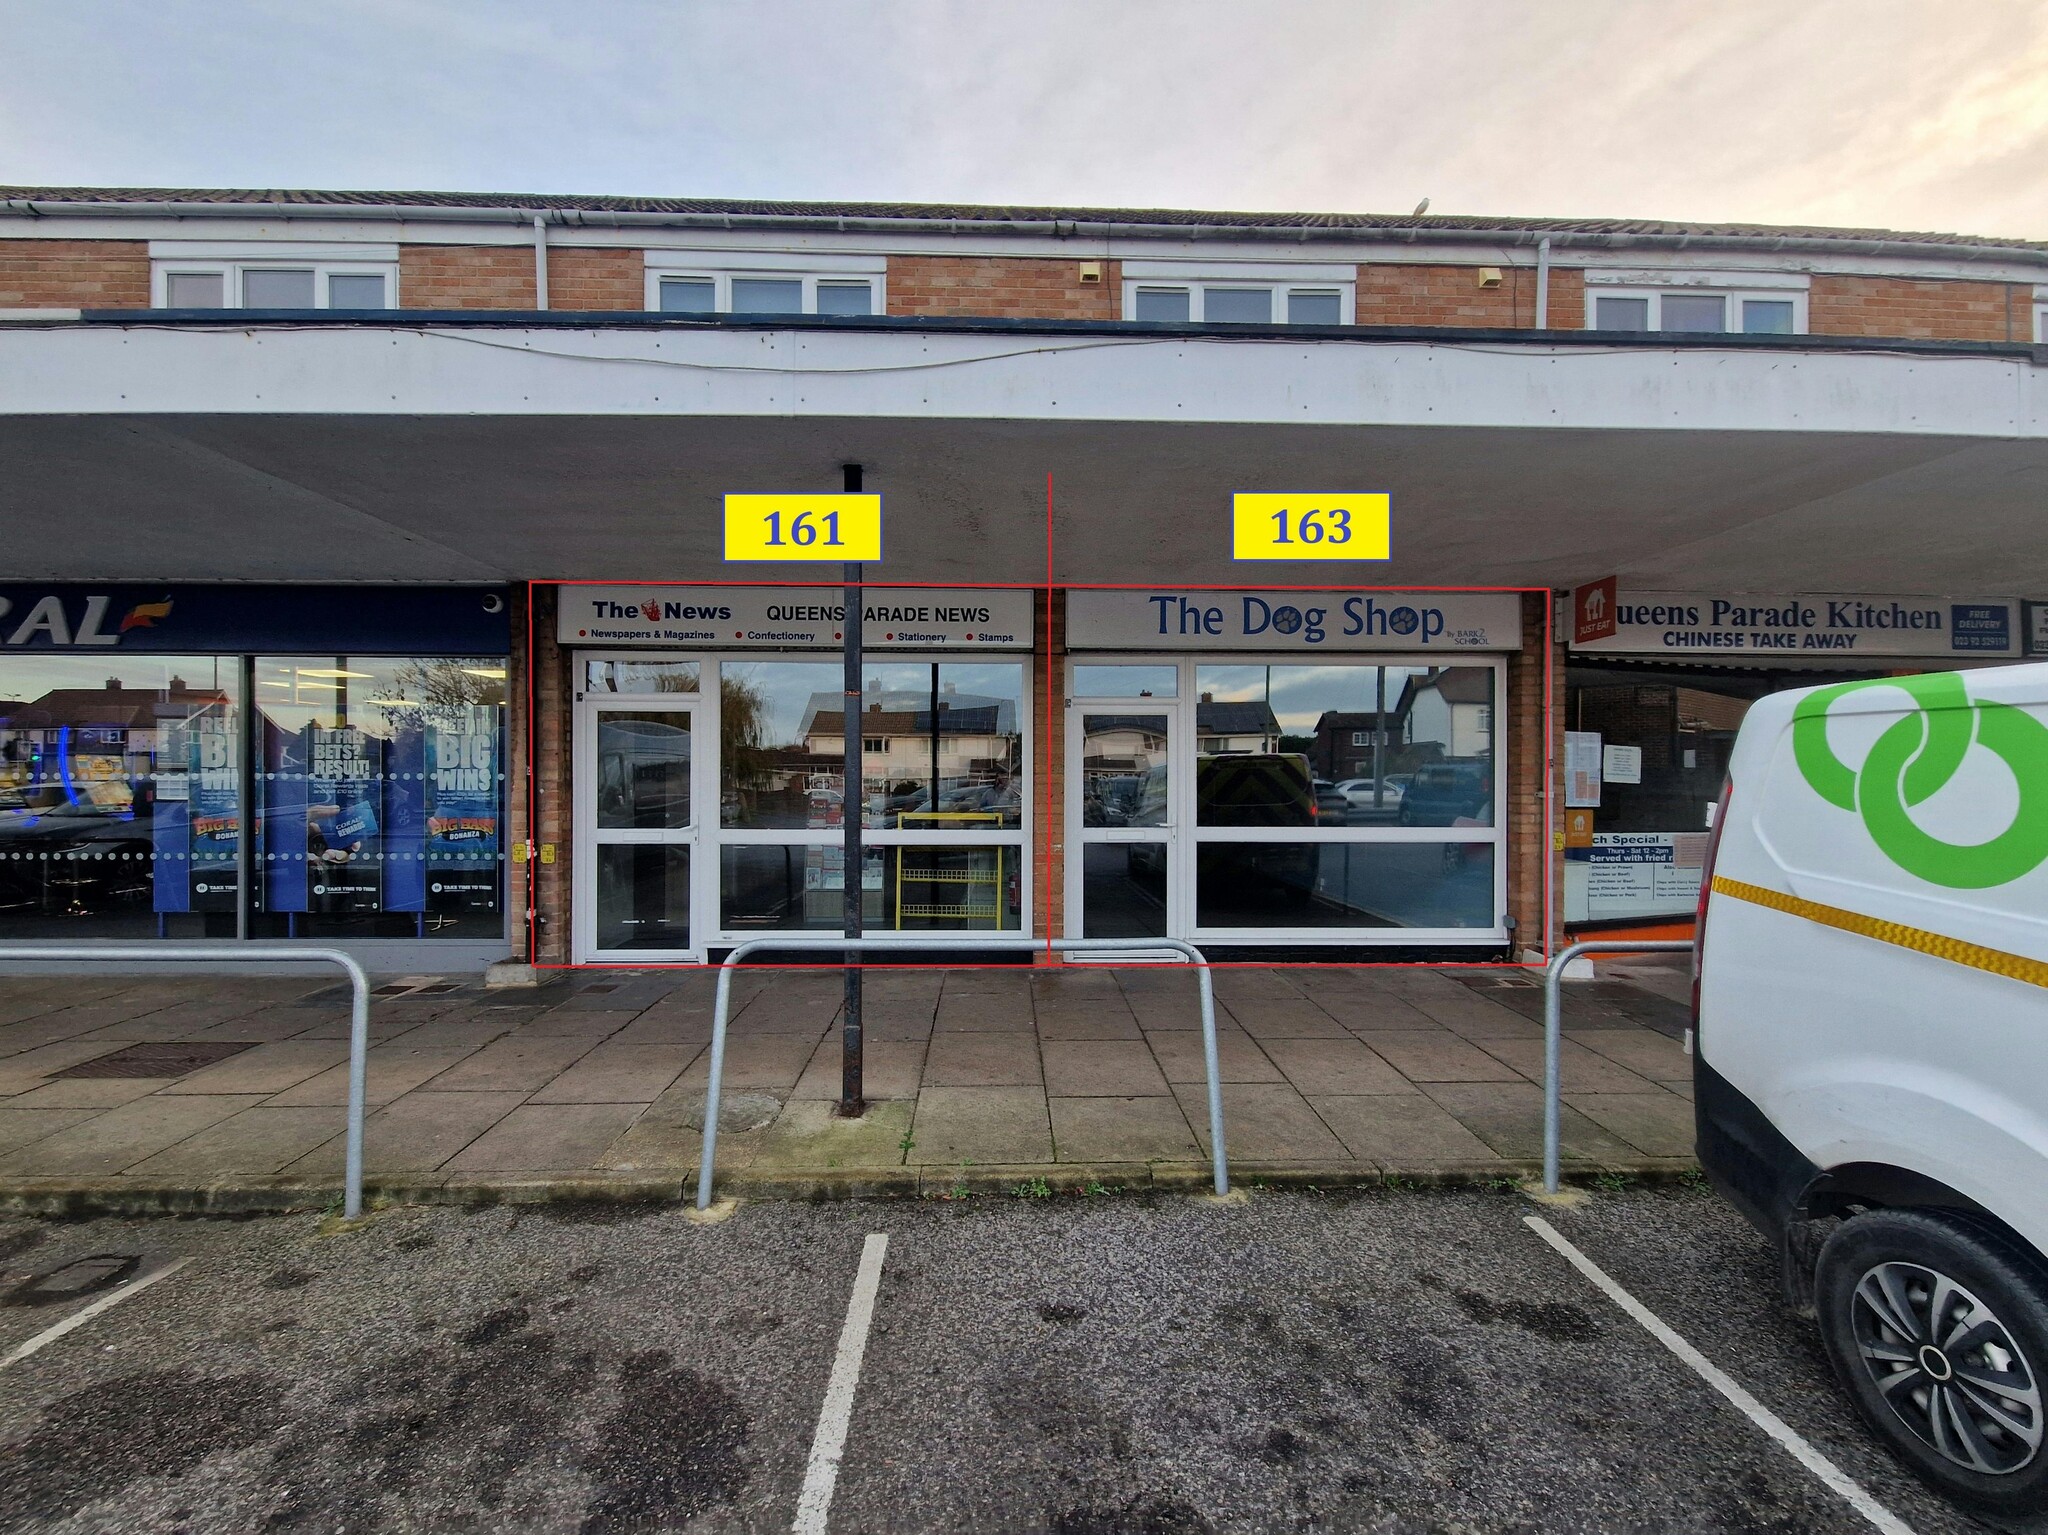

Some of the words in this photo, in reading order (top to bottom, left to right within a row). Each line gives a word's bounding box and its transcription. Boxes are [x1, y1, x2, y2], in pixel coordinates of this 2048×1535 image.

[592, 601, 639, 619] The
[664, 602, 731, 620] News
[767, 605, 845, 621] QUEENS
[863, 607, 929, 622] ARADE
[935, 607, 990, 622] NEWS
[1616, 605, 1700, 626] ueens
[1709, 599, 1816, 628] Parade
[1825, 601, 1942, 630] Kitchen
[1969, 610, 1991, 619] FREE
[1149, 596, 1224, 635] The
[1242, 597, 1327, 643] Dog
[1343, 597, 1444, 643] Shop
[1959, 620, 2001, 629] DELIVERY
[591, 629, 650, 640] Newspapers
[654, 630, 661, 639] &
[664, 630, 715, 640] Magazines
[1579, 623, 1597, 637] JUST
[1596, 619, 1611, 631] EAT
[747, 631, 815, 642] Confectionery
[898, 632, 947, 643] Stationery
[978, 633, 1014, 643] Stamps
[1663, 631, 1744, 647] CHINESE
[1750, 633, 1797, 648] TAKE
[1802, 633, 1857, 649] AWAY
[314, 728, 332, 744] IN
[336, 728, 366, 744] FREE
[314, 744, 361, 760] BETS?
[436, 734, 491, 769] BIG
[314, 759, 370, 775] RESULT!
[437, 768, 492, 791] WINS
[449, 831, 480, 841] BONANZA
[1612, 835, 1659, 845] Special
[1590, 854, 1621, 862] Served
